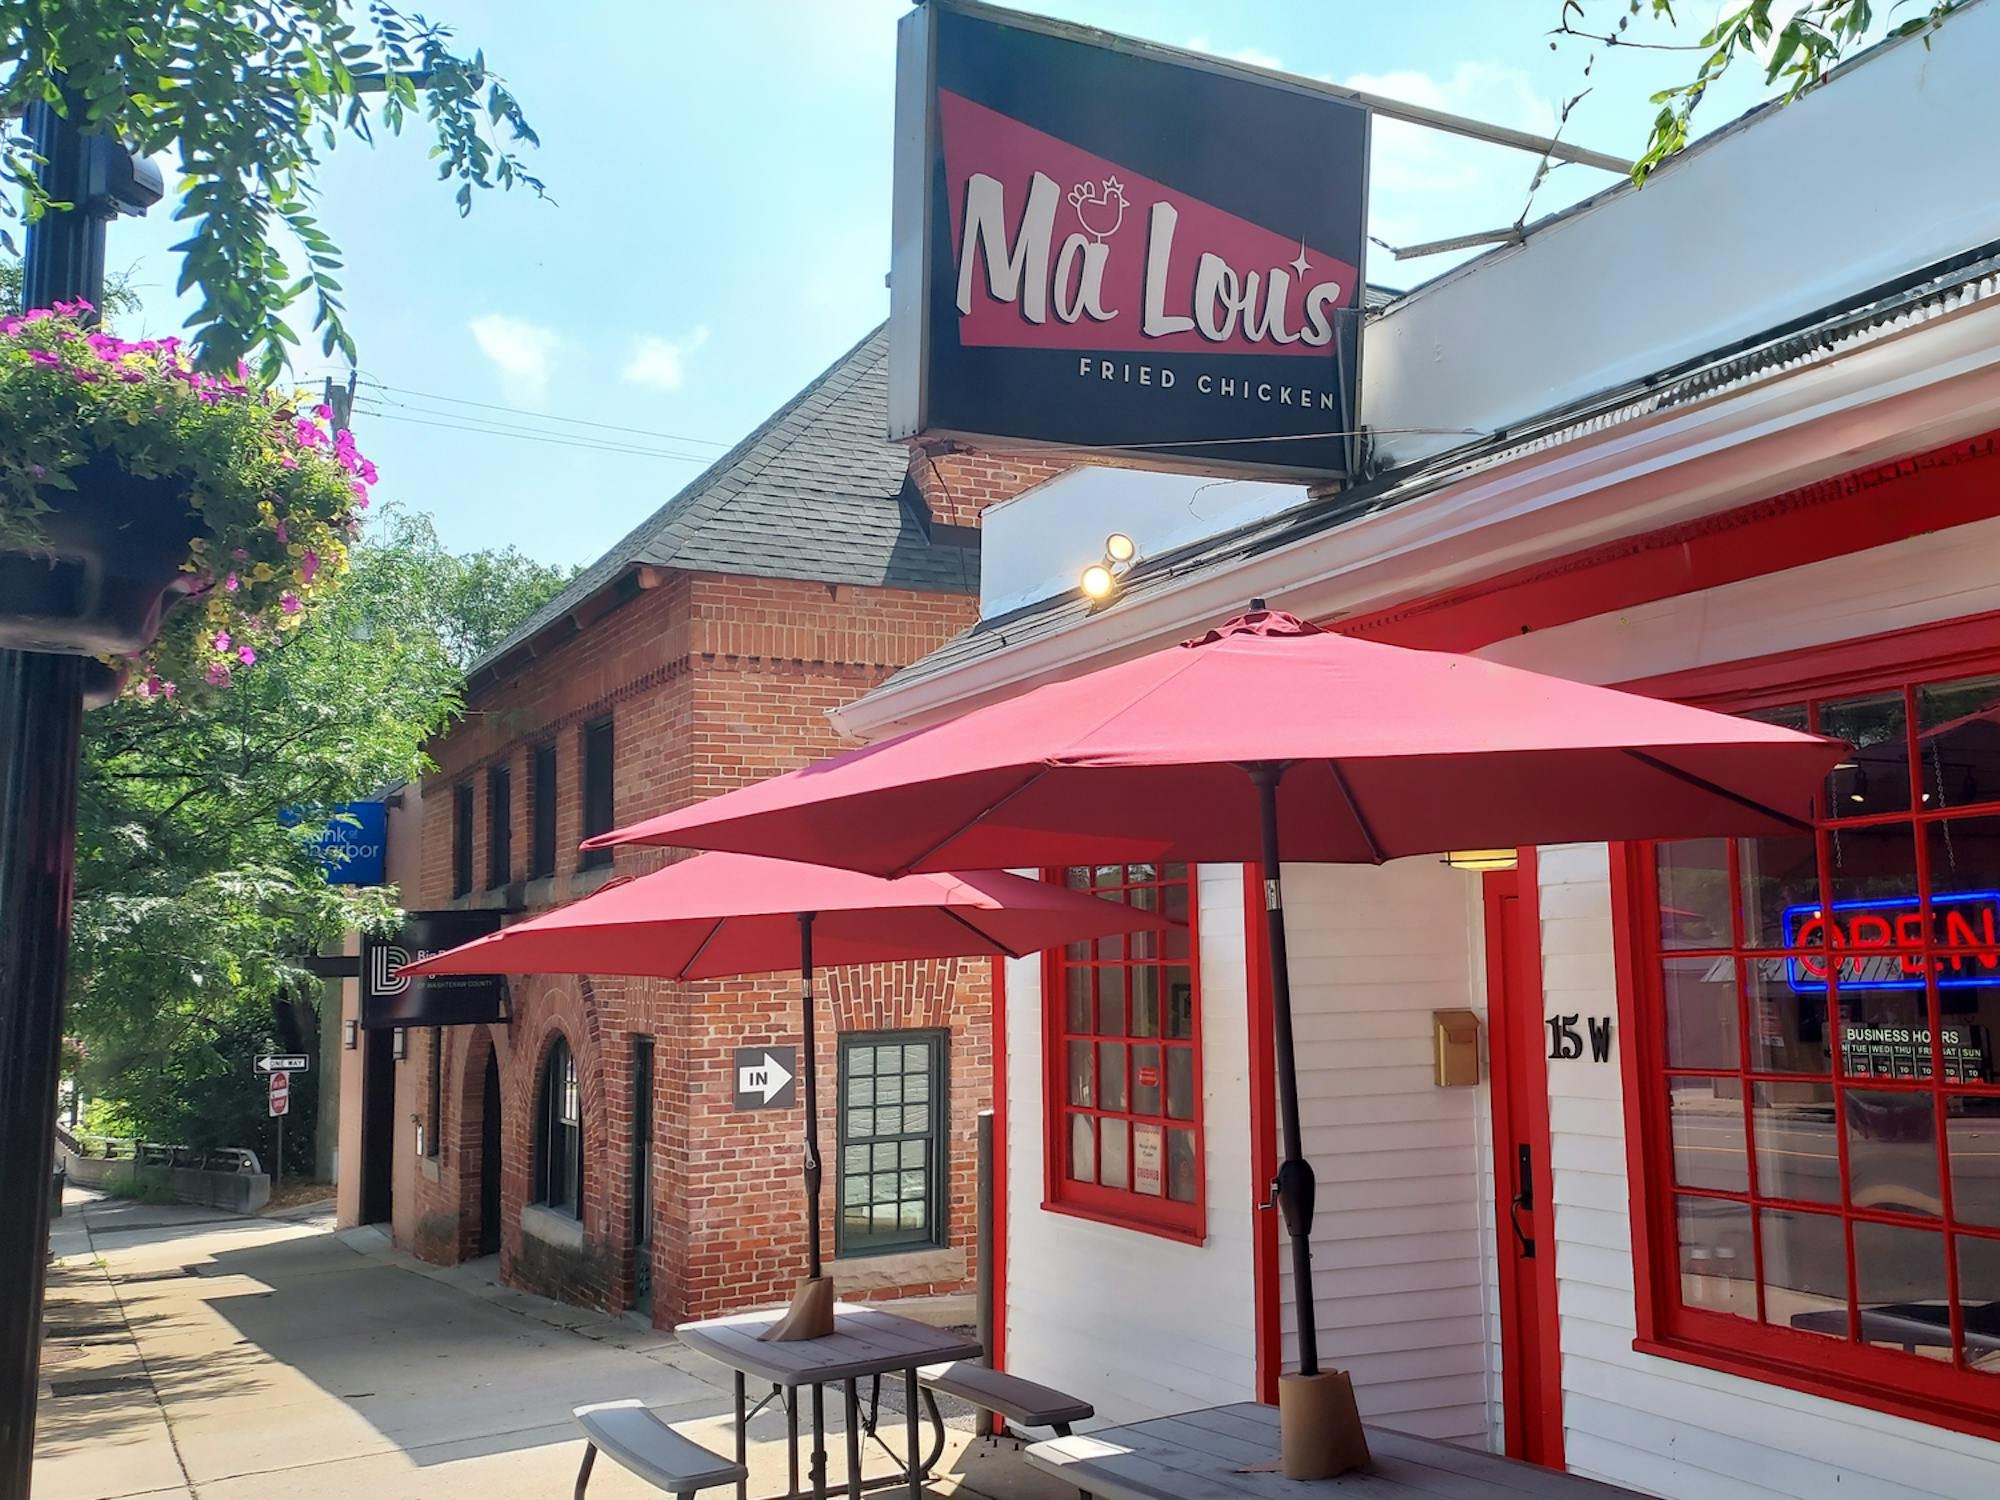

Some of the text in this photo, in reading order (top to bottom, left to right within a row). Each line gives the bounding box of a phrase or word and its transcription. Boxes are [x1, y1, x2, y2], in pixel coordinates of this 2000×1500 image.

[956, 171, 1119, 323] Ma
[1079, 358, 1333, 410] FRIED CHICKEN
[1797, 908, 1997, 978] OPEN
[1545, 1013, 1610, 1063] 15 W
[1847, 1028, 1959, 1044] BUSINESS HORS
[1852, 1044, 1868, 1053] TUE
[1872, 1045, 1891, 1053] WED
[1895, 1046, 1912, 1055] THU
[1962, 1048, 1981, 1057] SUN
[750, 1071, 768, 1086] IN
